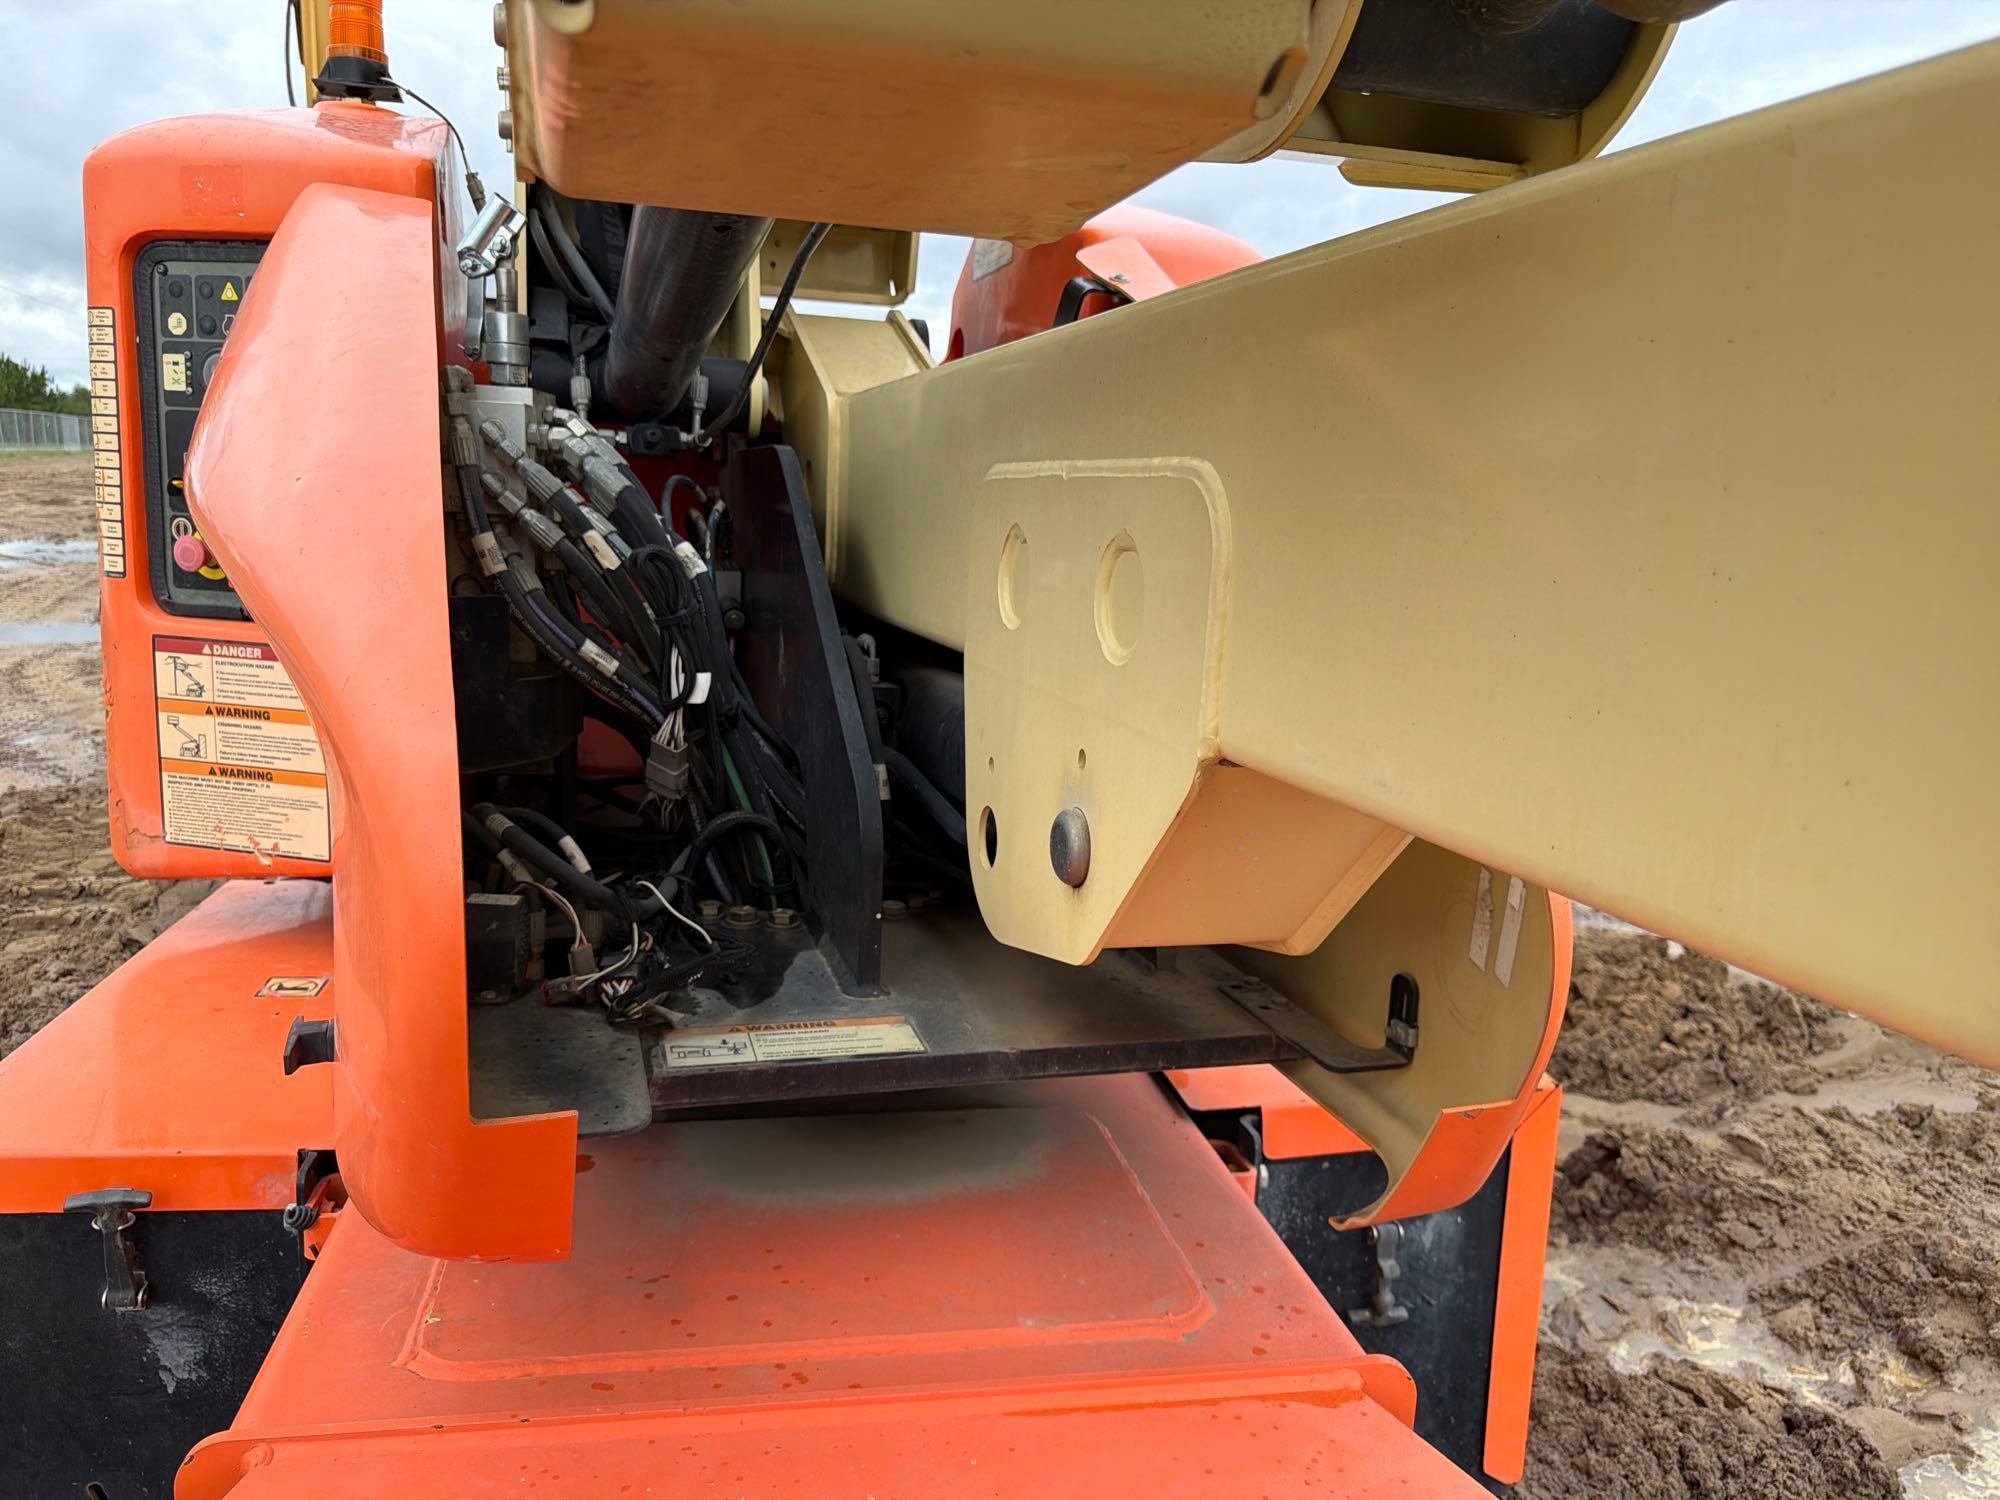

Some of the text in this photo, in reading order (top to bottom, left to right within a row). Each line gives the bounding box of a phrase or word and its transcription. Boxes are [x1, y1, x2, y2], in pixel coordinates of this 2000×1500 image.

[212, 644, 262, 658] DANGER
[216, 706, 271, 720] WARNING
[219, 766, 273, 782] WARNING
[746, 1020, 836, 1032] WARNING
